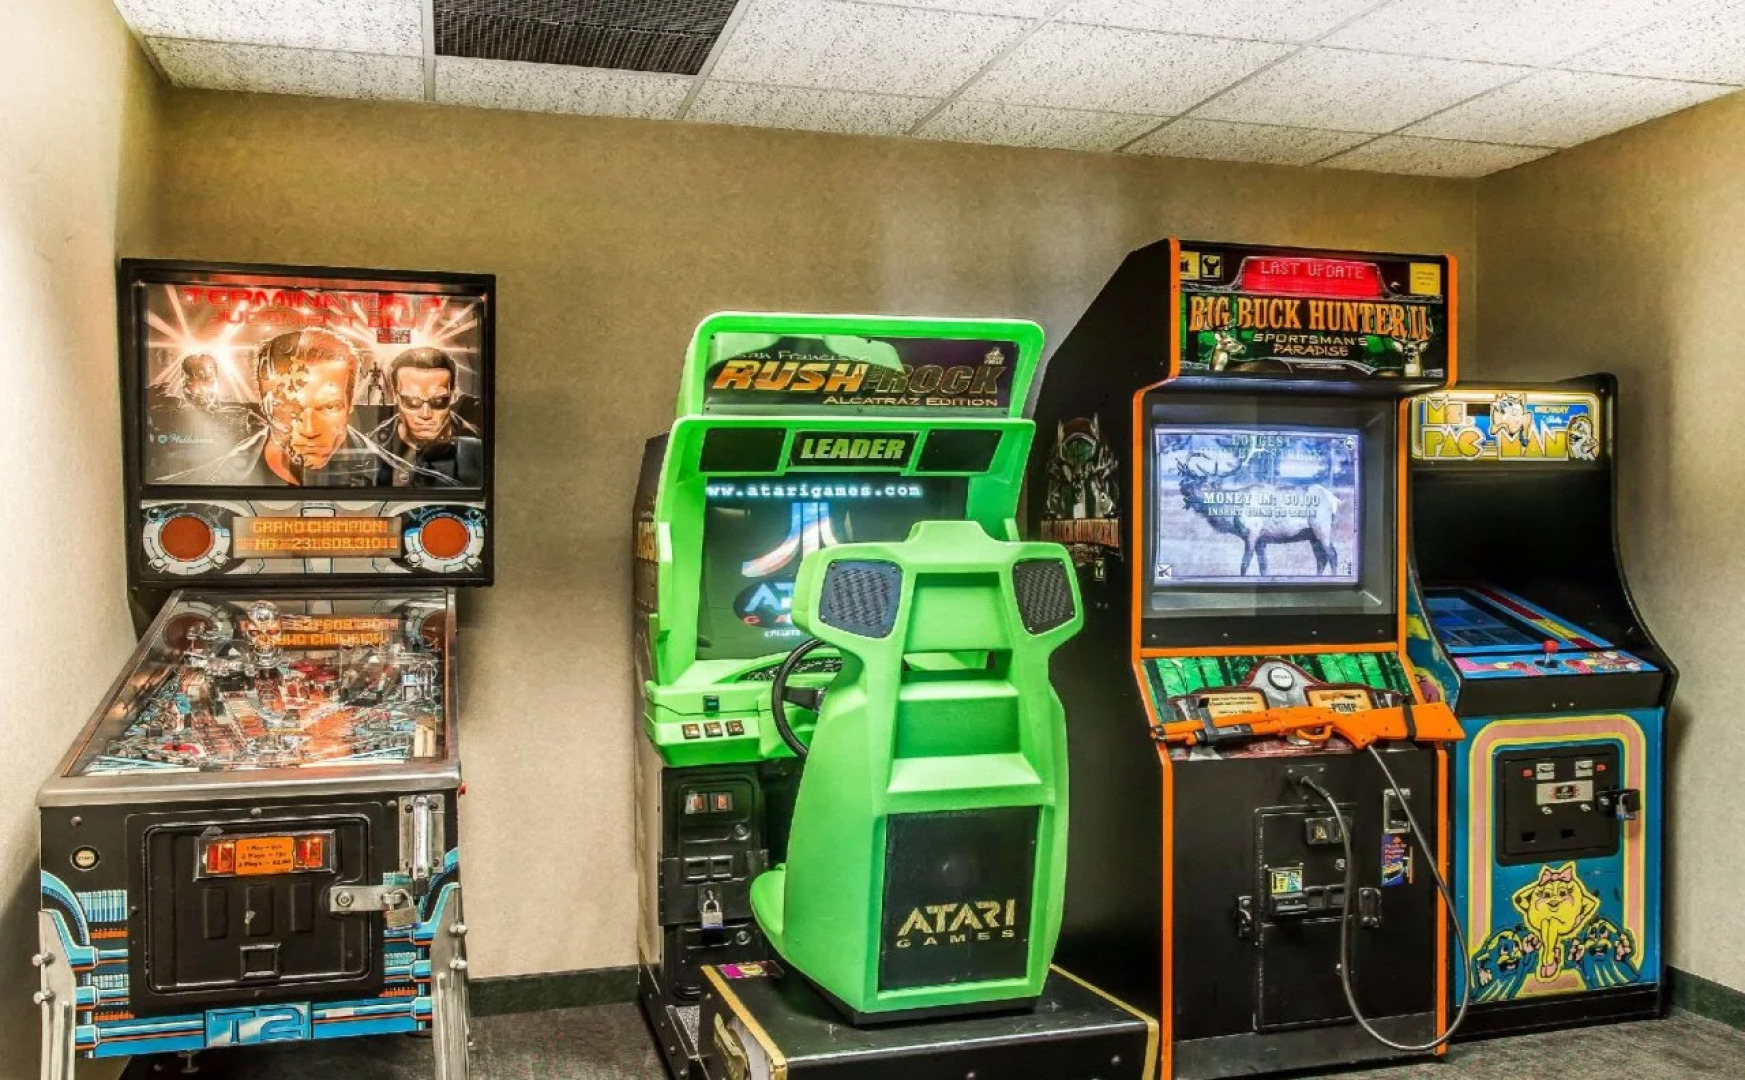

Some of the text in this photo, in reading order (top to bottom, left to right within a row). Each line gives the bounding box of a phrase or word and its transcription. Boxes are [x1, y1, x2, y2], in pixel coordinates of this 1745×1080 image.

[1260, 261, 1365, 280] LAST UPDATE
[182, 286, 415, 313] TERMINATOR
[1189, 295, 1430, 341] BIG BUCK HUNTER II
[1253, 333, 1368, 347] SPORTSMAN'S
[1273, 344, 1350, 358] PARADISE
[712, 360, 869, 394] RUSH
[875, 365, 1006, 395] ROCK
[822, 395, 999, 408] ALCATRAZ EDITION
[800, 438, 906, 460] LEADER
[1203, 491, 1251, 505] MONEY
[253, 520, 304, 534] GRAND
[896, 898, 1015, 936] ATARI
[896, 930, 1015, 949] GAMES
